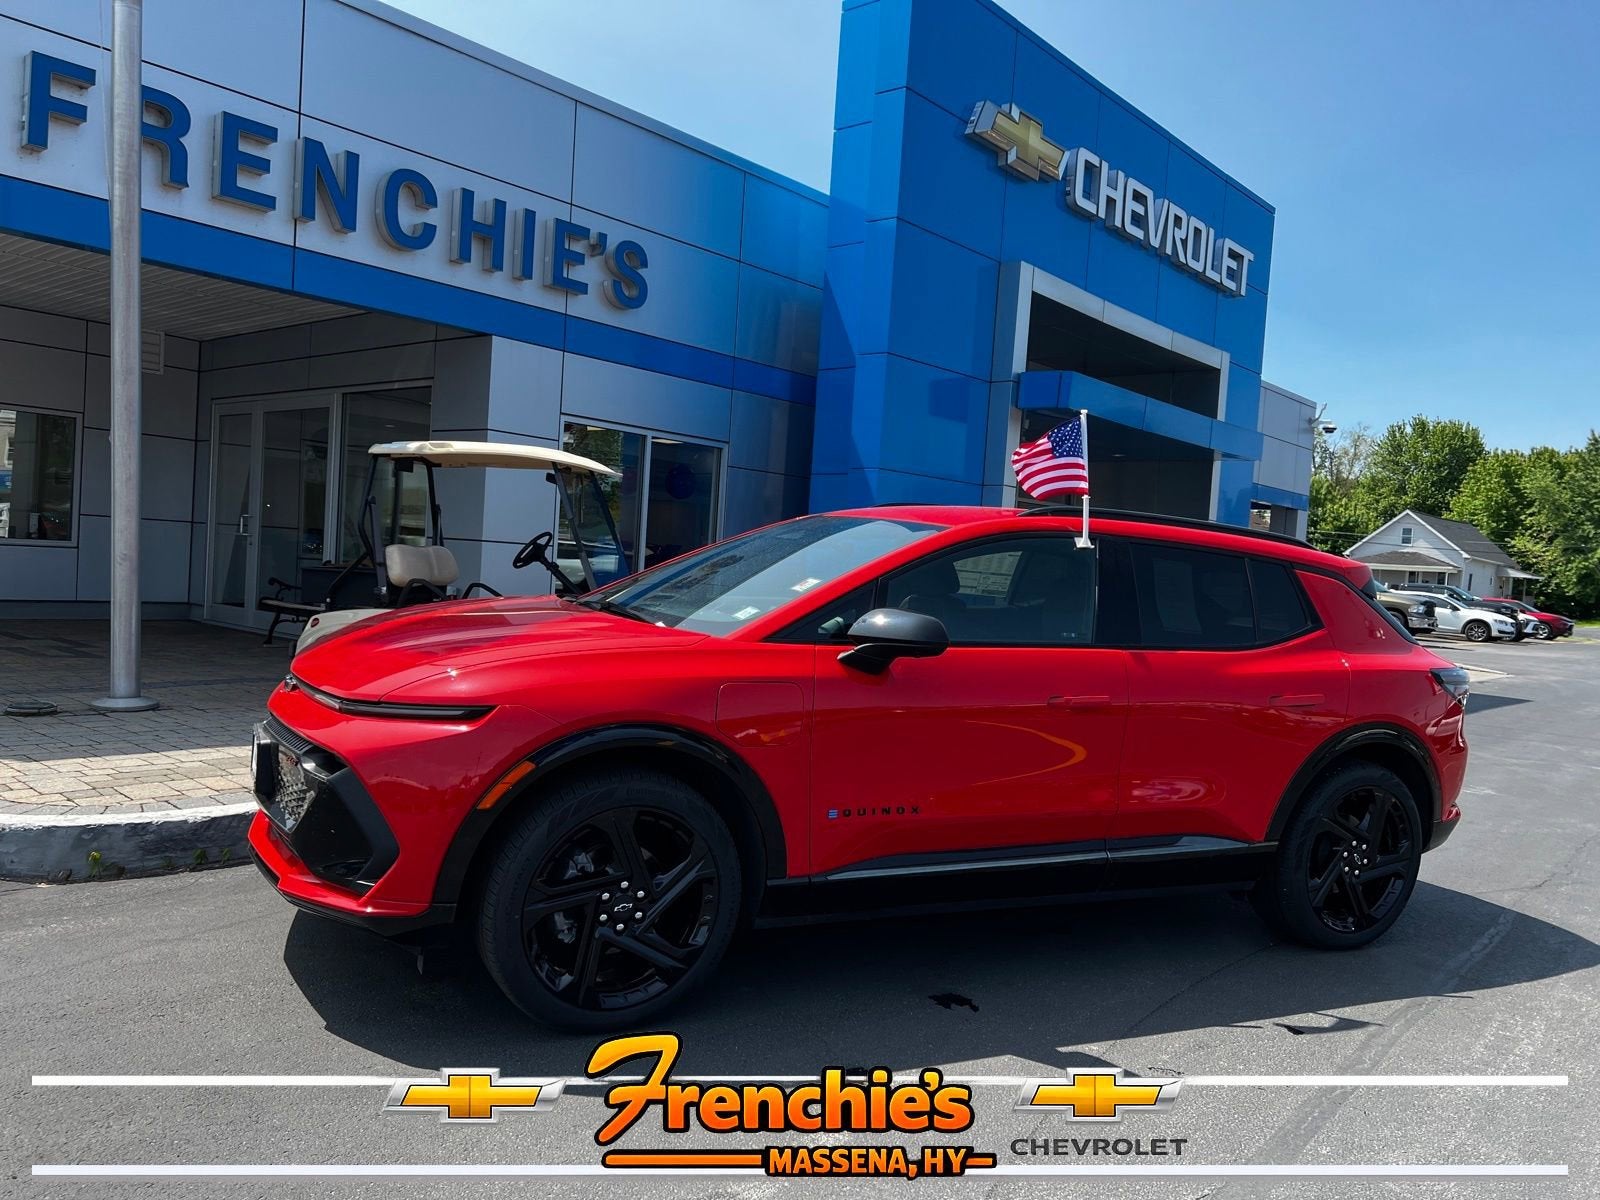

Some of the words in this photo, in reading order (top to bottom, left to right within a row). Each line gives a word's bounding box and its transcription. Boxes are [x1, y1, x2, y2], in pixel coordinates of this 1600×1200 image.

[21, 51, 650, 310] FRENCHIE'S
[1066, 147, 1255, 298] CHEVROLET
[827, 805, 921, 820] EQUINOX
